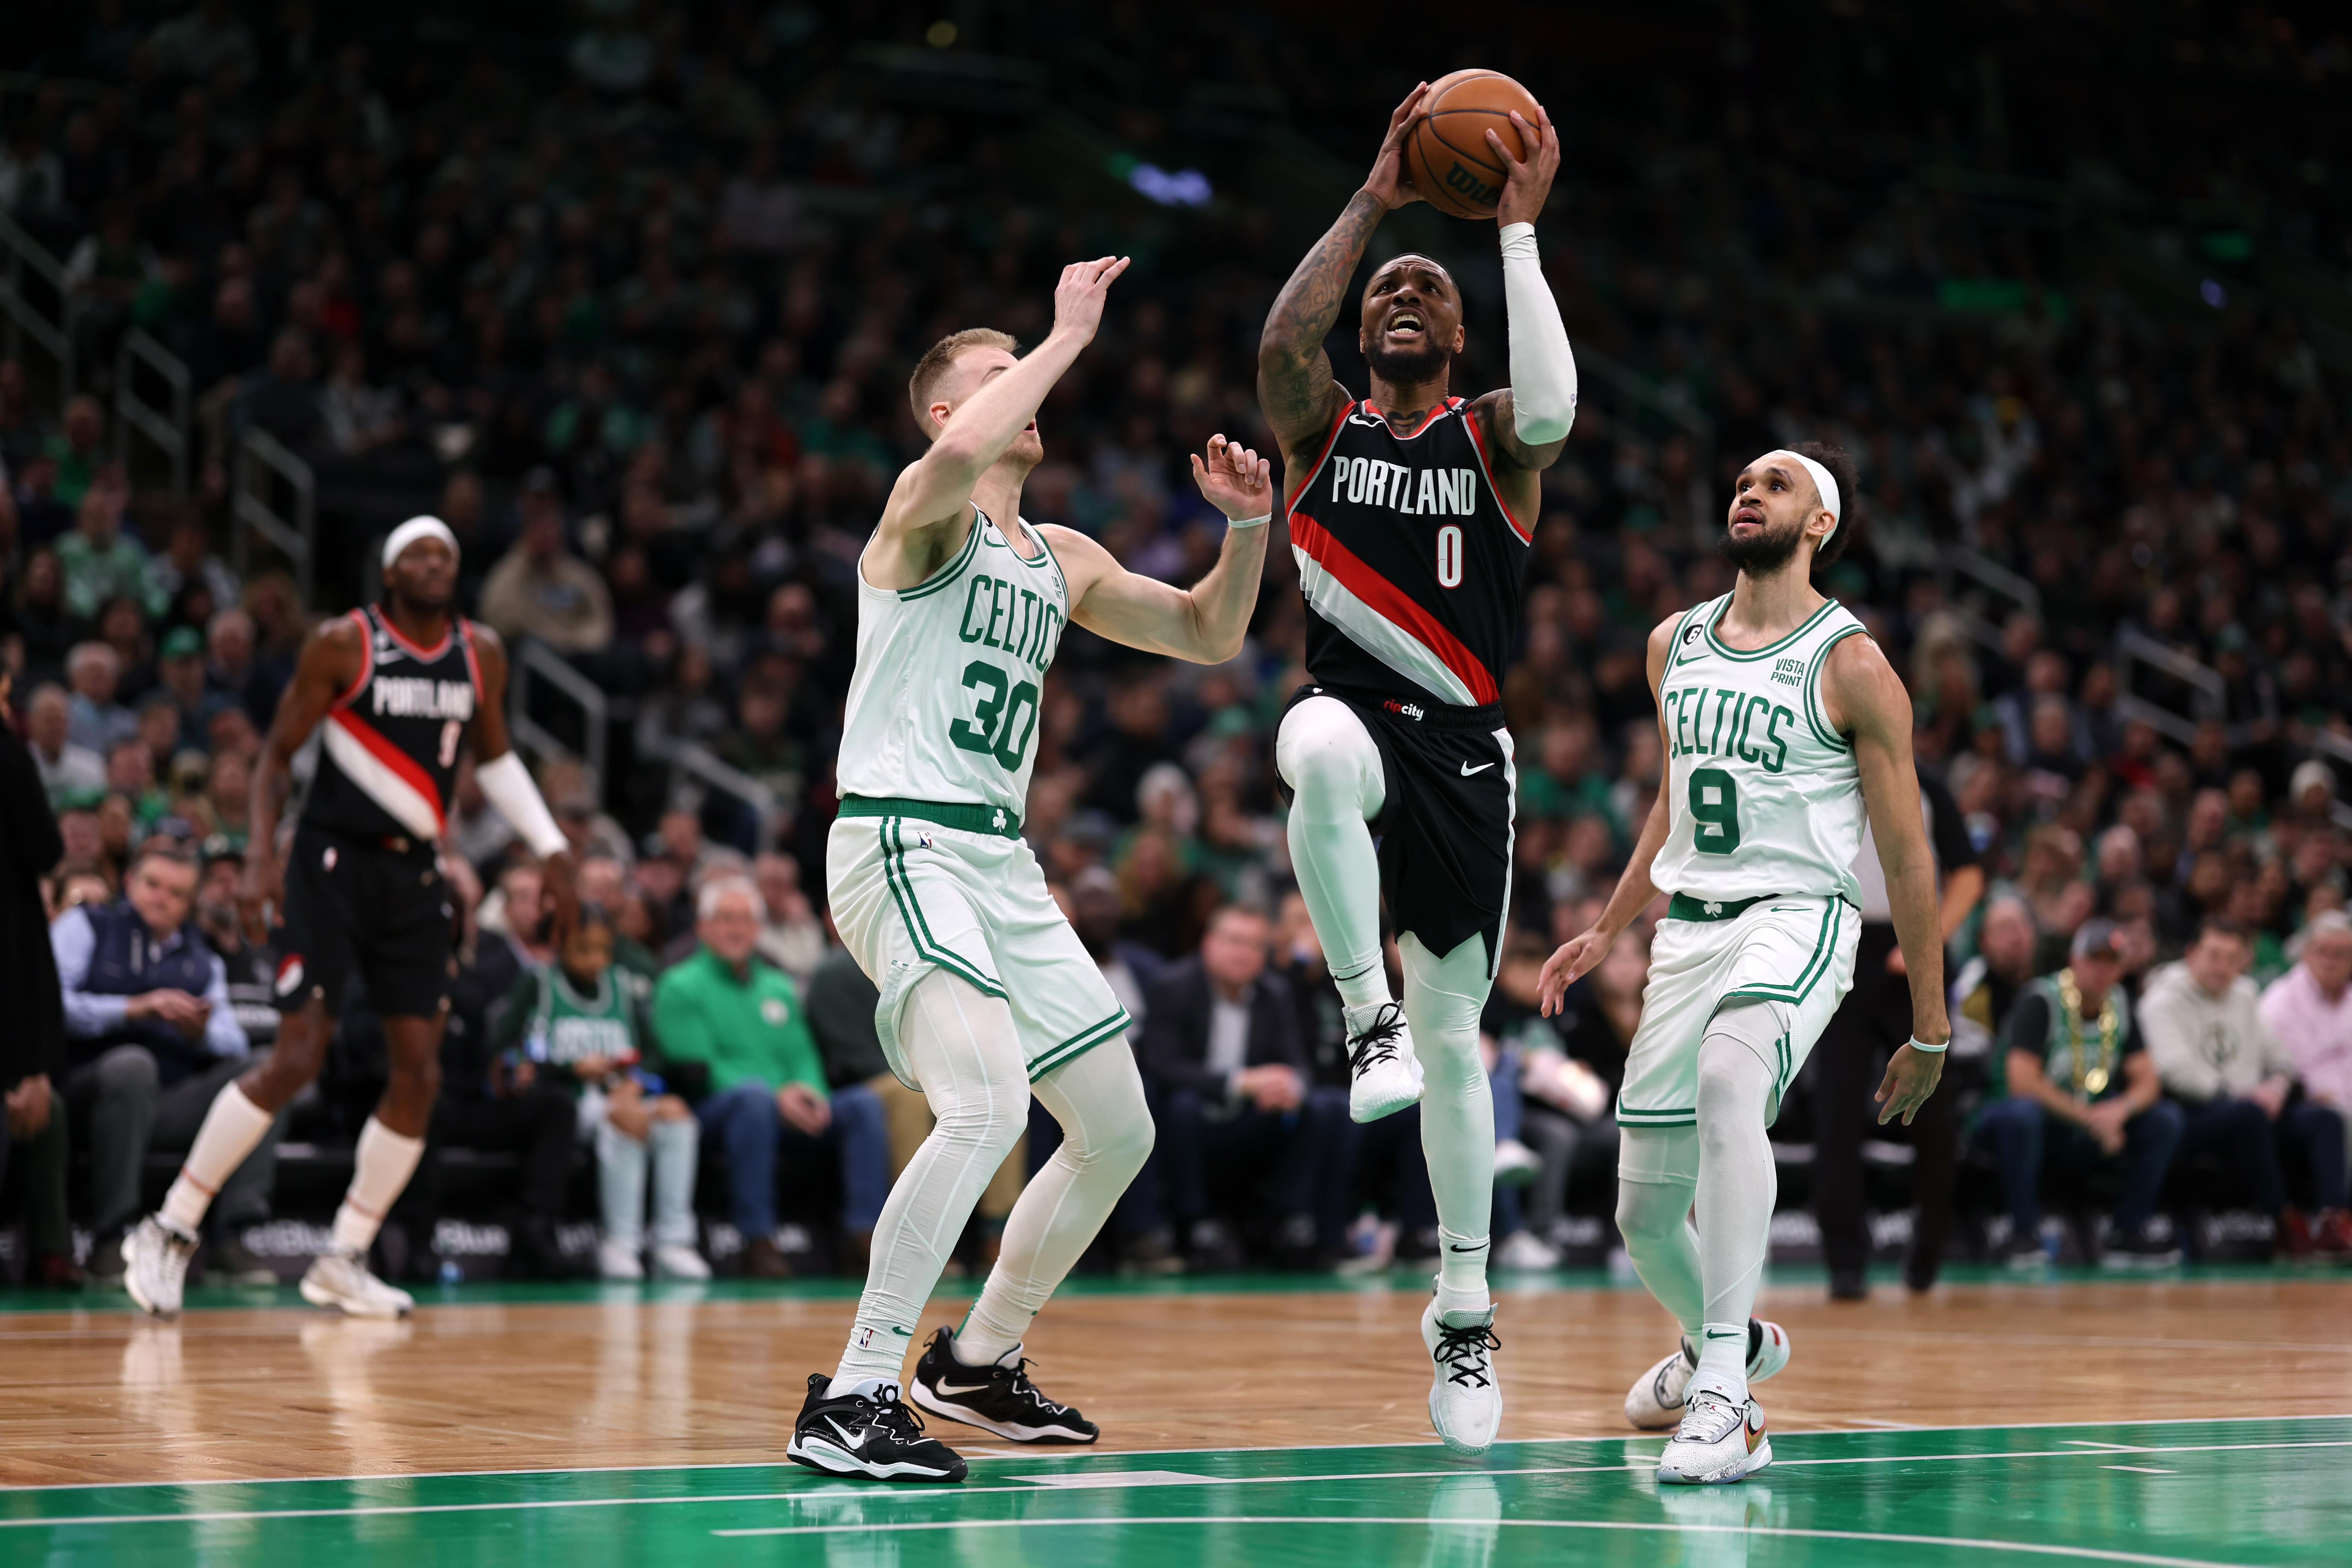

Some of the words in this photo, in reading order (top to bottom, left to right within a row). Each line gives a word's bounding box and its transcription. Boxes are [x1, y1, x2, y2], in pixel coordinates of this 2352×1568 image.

[1446, 160, 1499, 208] Wils
[1333, 456, 1476, 515] PORTLAND
[1437, 524, 1463, 589] 0
[1687, 626, 1702, 643] 6
[1770, 671, 1802, 687] PRINT
[1775, 658, 1805, 676] VISTA
[949, 660, 1038, 773] 30
[1664, 687, 1795, 773] CELTICS
[1688, 768, 1740, 855] 9
